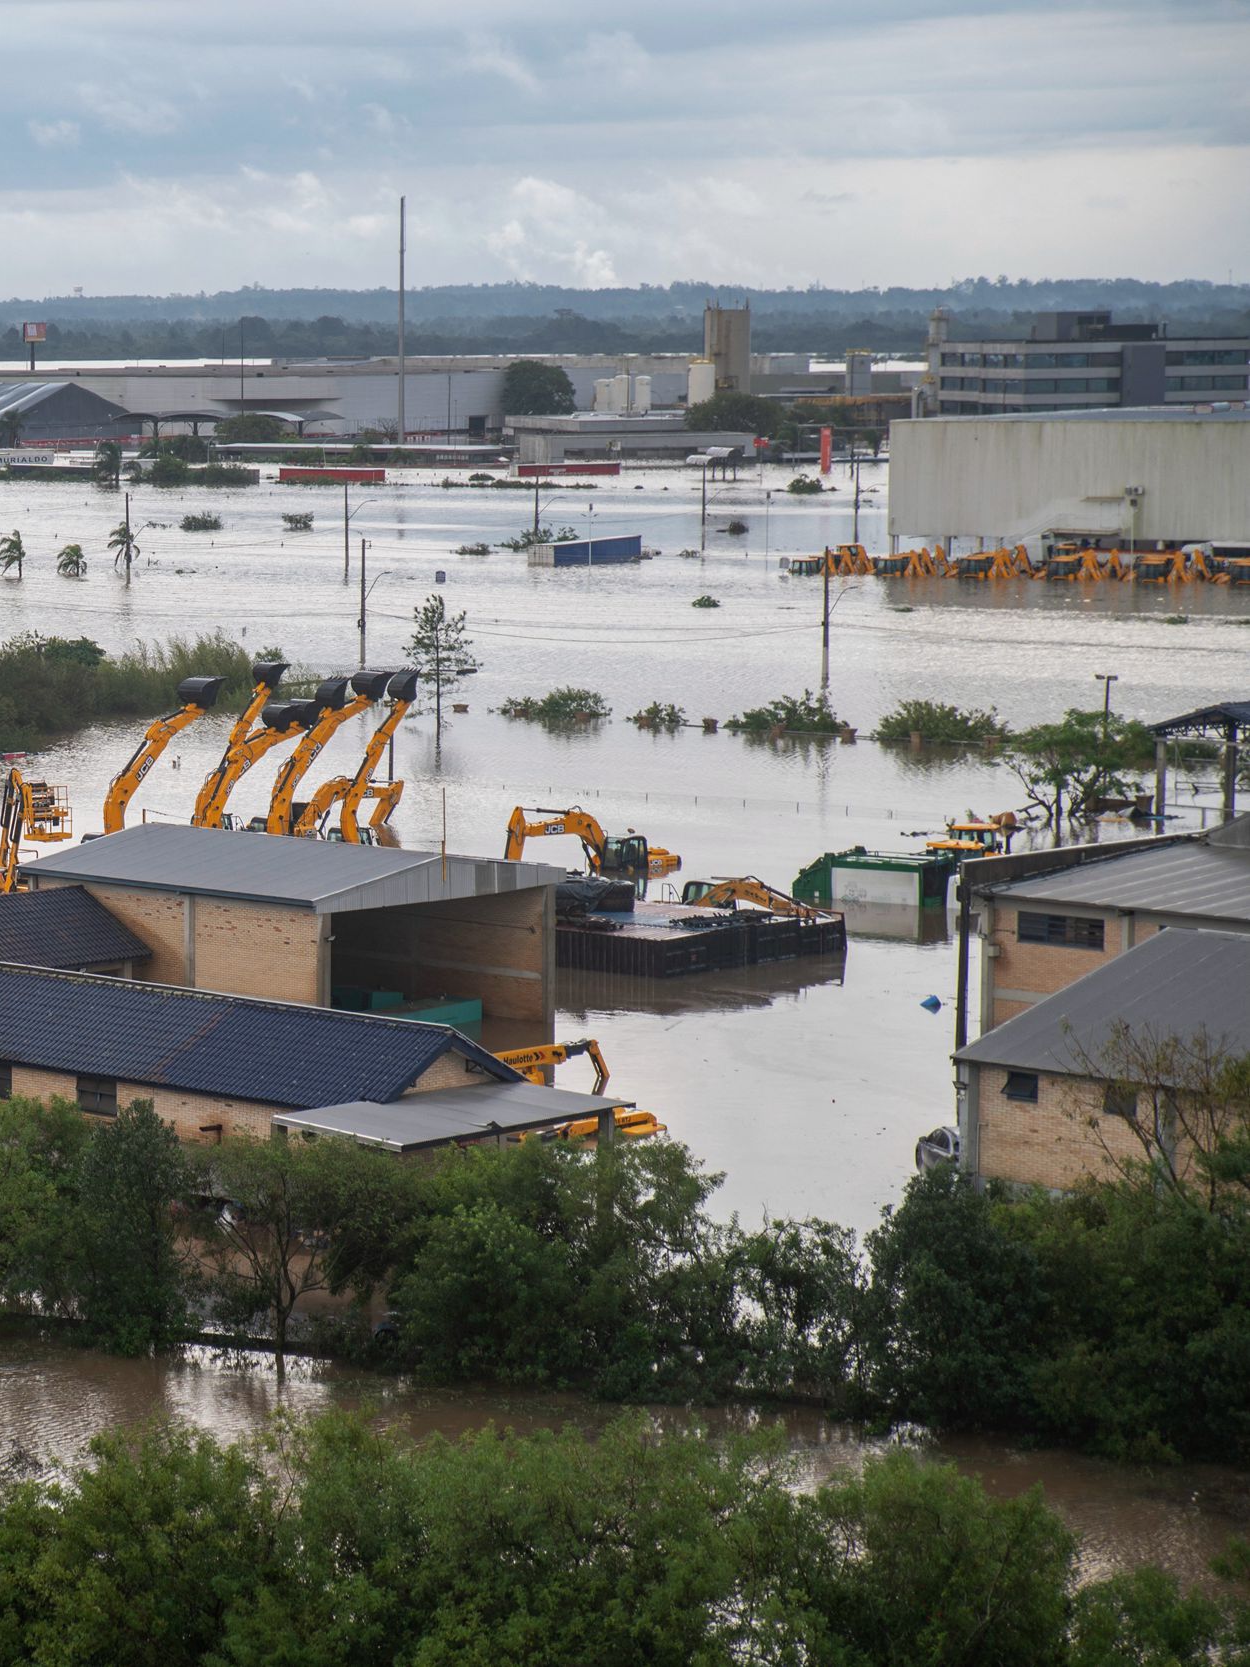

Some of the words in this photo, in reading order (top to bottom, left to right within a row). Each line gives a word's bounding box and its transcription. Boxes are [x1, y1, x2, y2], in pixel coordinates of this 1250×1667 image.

[136, 755, 154, 780] JCB
[545, 824, 565, 834] JCB
[504, 1054, 534, 1065] Haulotte
